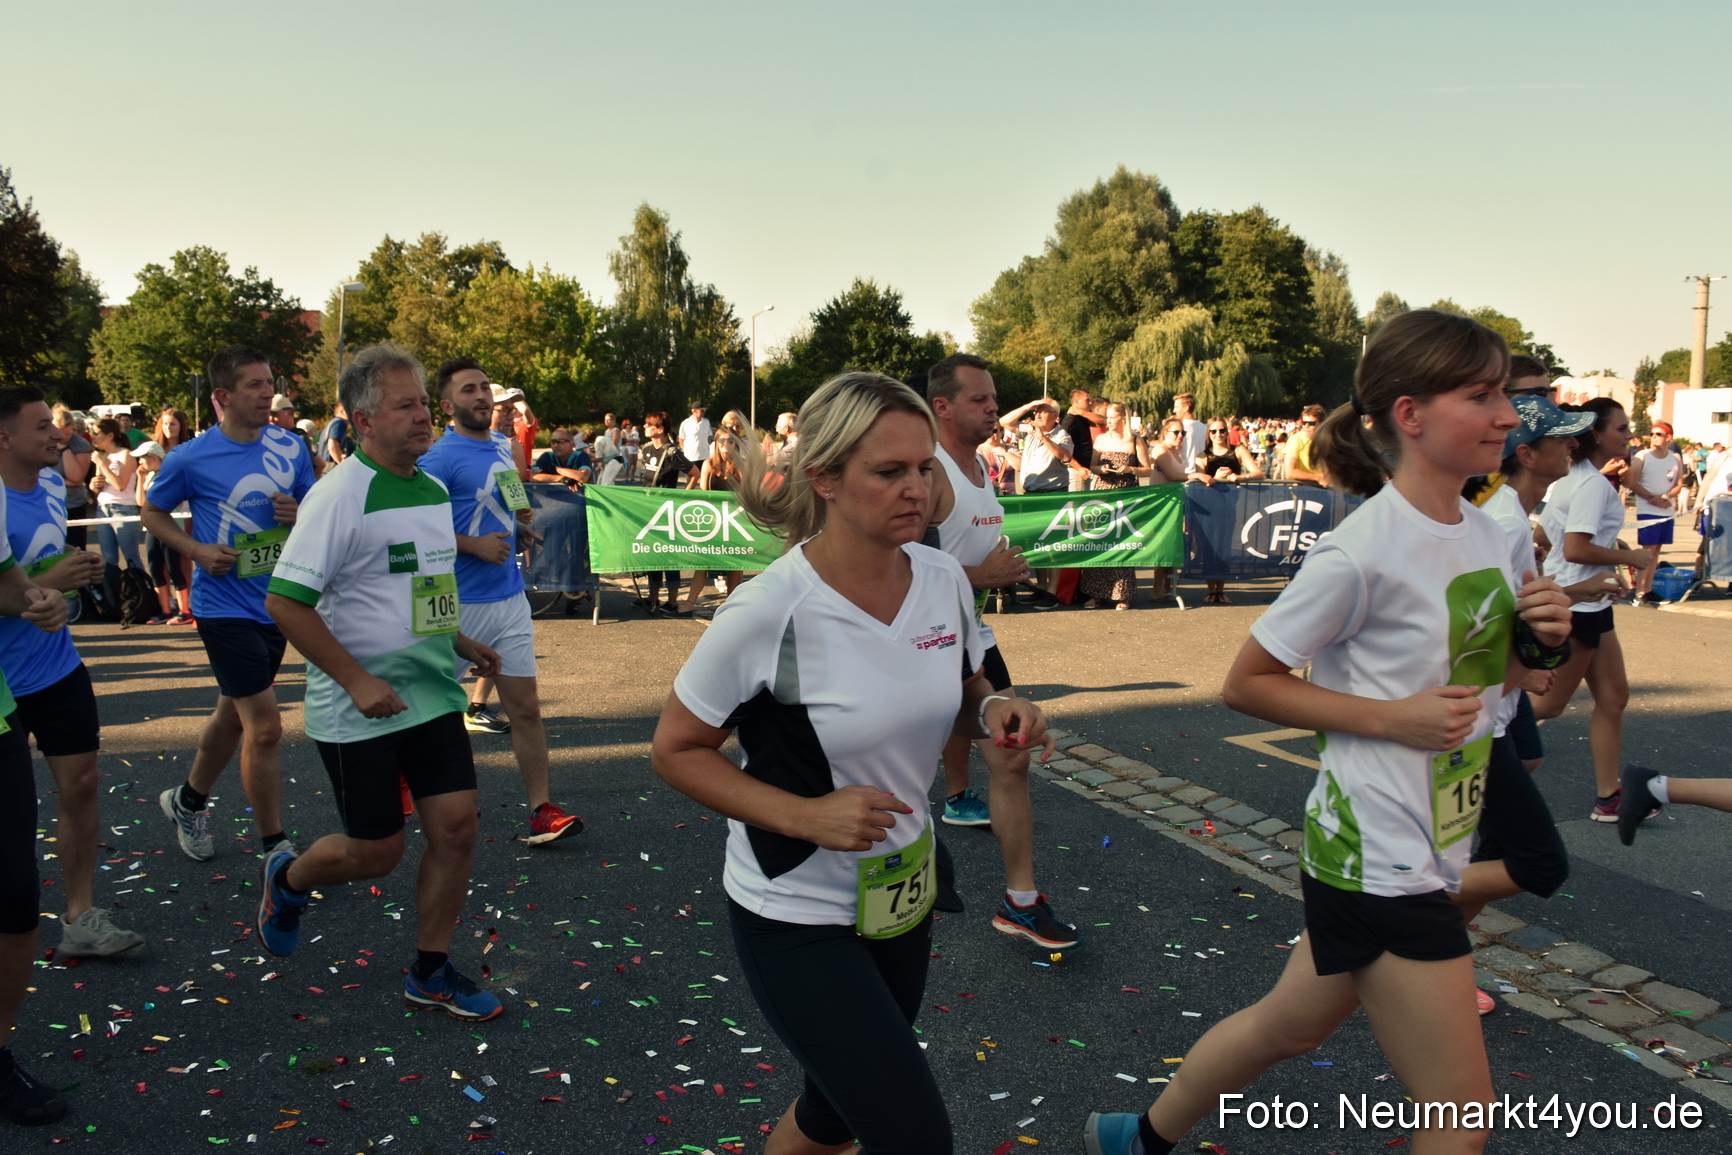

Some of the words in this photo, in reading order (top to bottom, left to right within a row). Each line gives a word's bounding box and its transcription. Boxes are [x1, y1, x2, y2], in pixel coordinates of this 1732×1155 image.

[506, 483, 525, 499] 385
[238, 497, 270, 508] anders
[634, 499, 756, 543] AOK
[1038, 499, 1145, 541] AOK
[250, 543, 282, 564] 378
[632, 543, 651, 554] Die
[653, 542, 757, 555] Gesundheitskasse.
[1033, 542, 1051, 552] Die
[1053, 541, 1147, 553] Gesundheitskasse.
[389, 553, 417, 564] BayWa
[1278, 555, 1306, 565] AU
[428, 594, 456, 617] 106
[886, 858, 929, 914] 757
